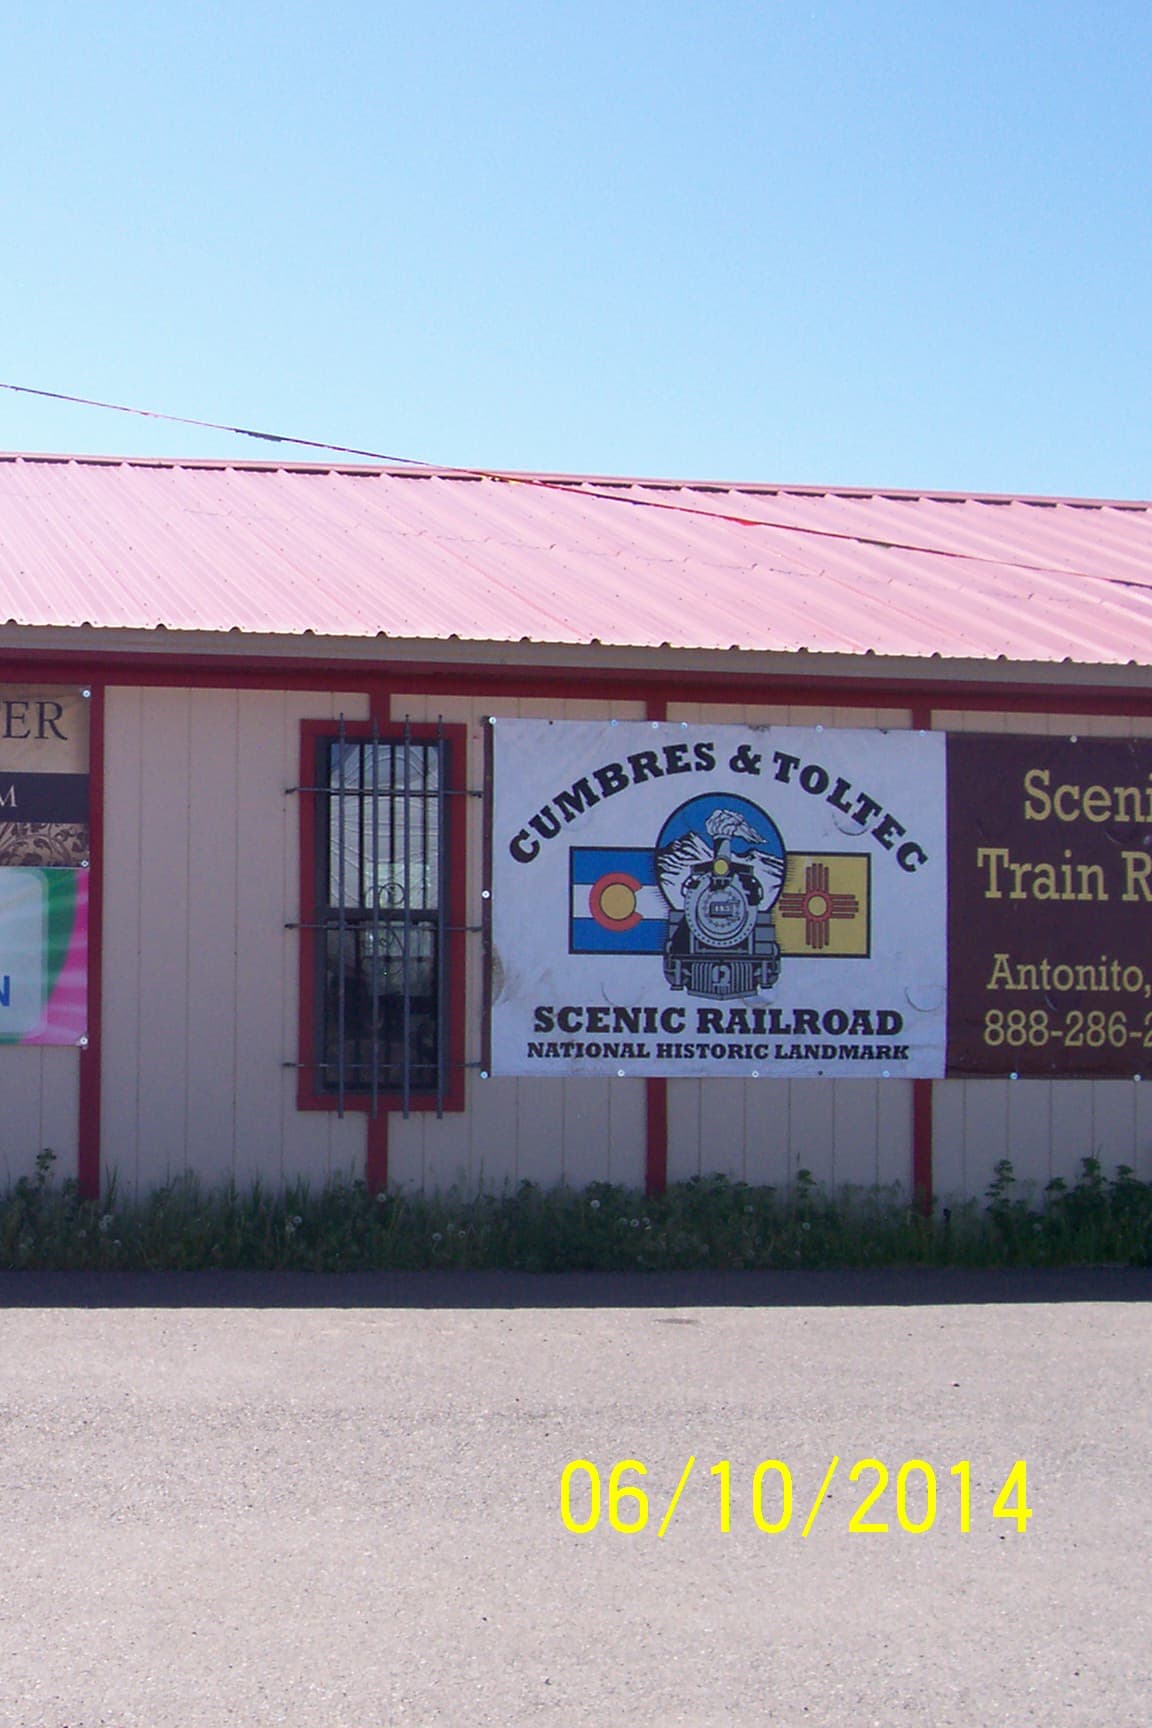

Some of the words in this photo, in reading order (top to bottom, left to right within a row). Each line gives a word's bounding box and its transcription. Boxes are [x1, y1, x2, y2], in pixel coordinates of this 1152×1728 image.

[509, 742, 716, 864] CUMBRES
[729, 744, 761, 776] &
[773, 751, 929, 872] TOLTEC
[977, 848, 1108, 901] Train
[1121, 851, 1152, 902] R
[987, 954, 1150, 998] Antonito,
[534, 1007, 686, 1034] SCENIC
[697, 1008, 904, 1036] RAILROAD
[527, 1042, 650, 1059] NATIONAL
[656, 1043, 768, 1060] HISTORIC
[774, 1044, 909, 1060] LANDMARK
